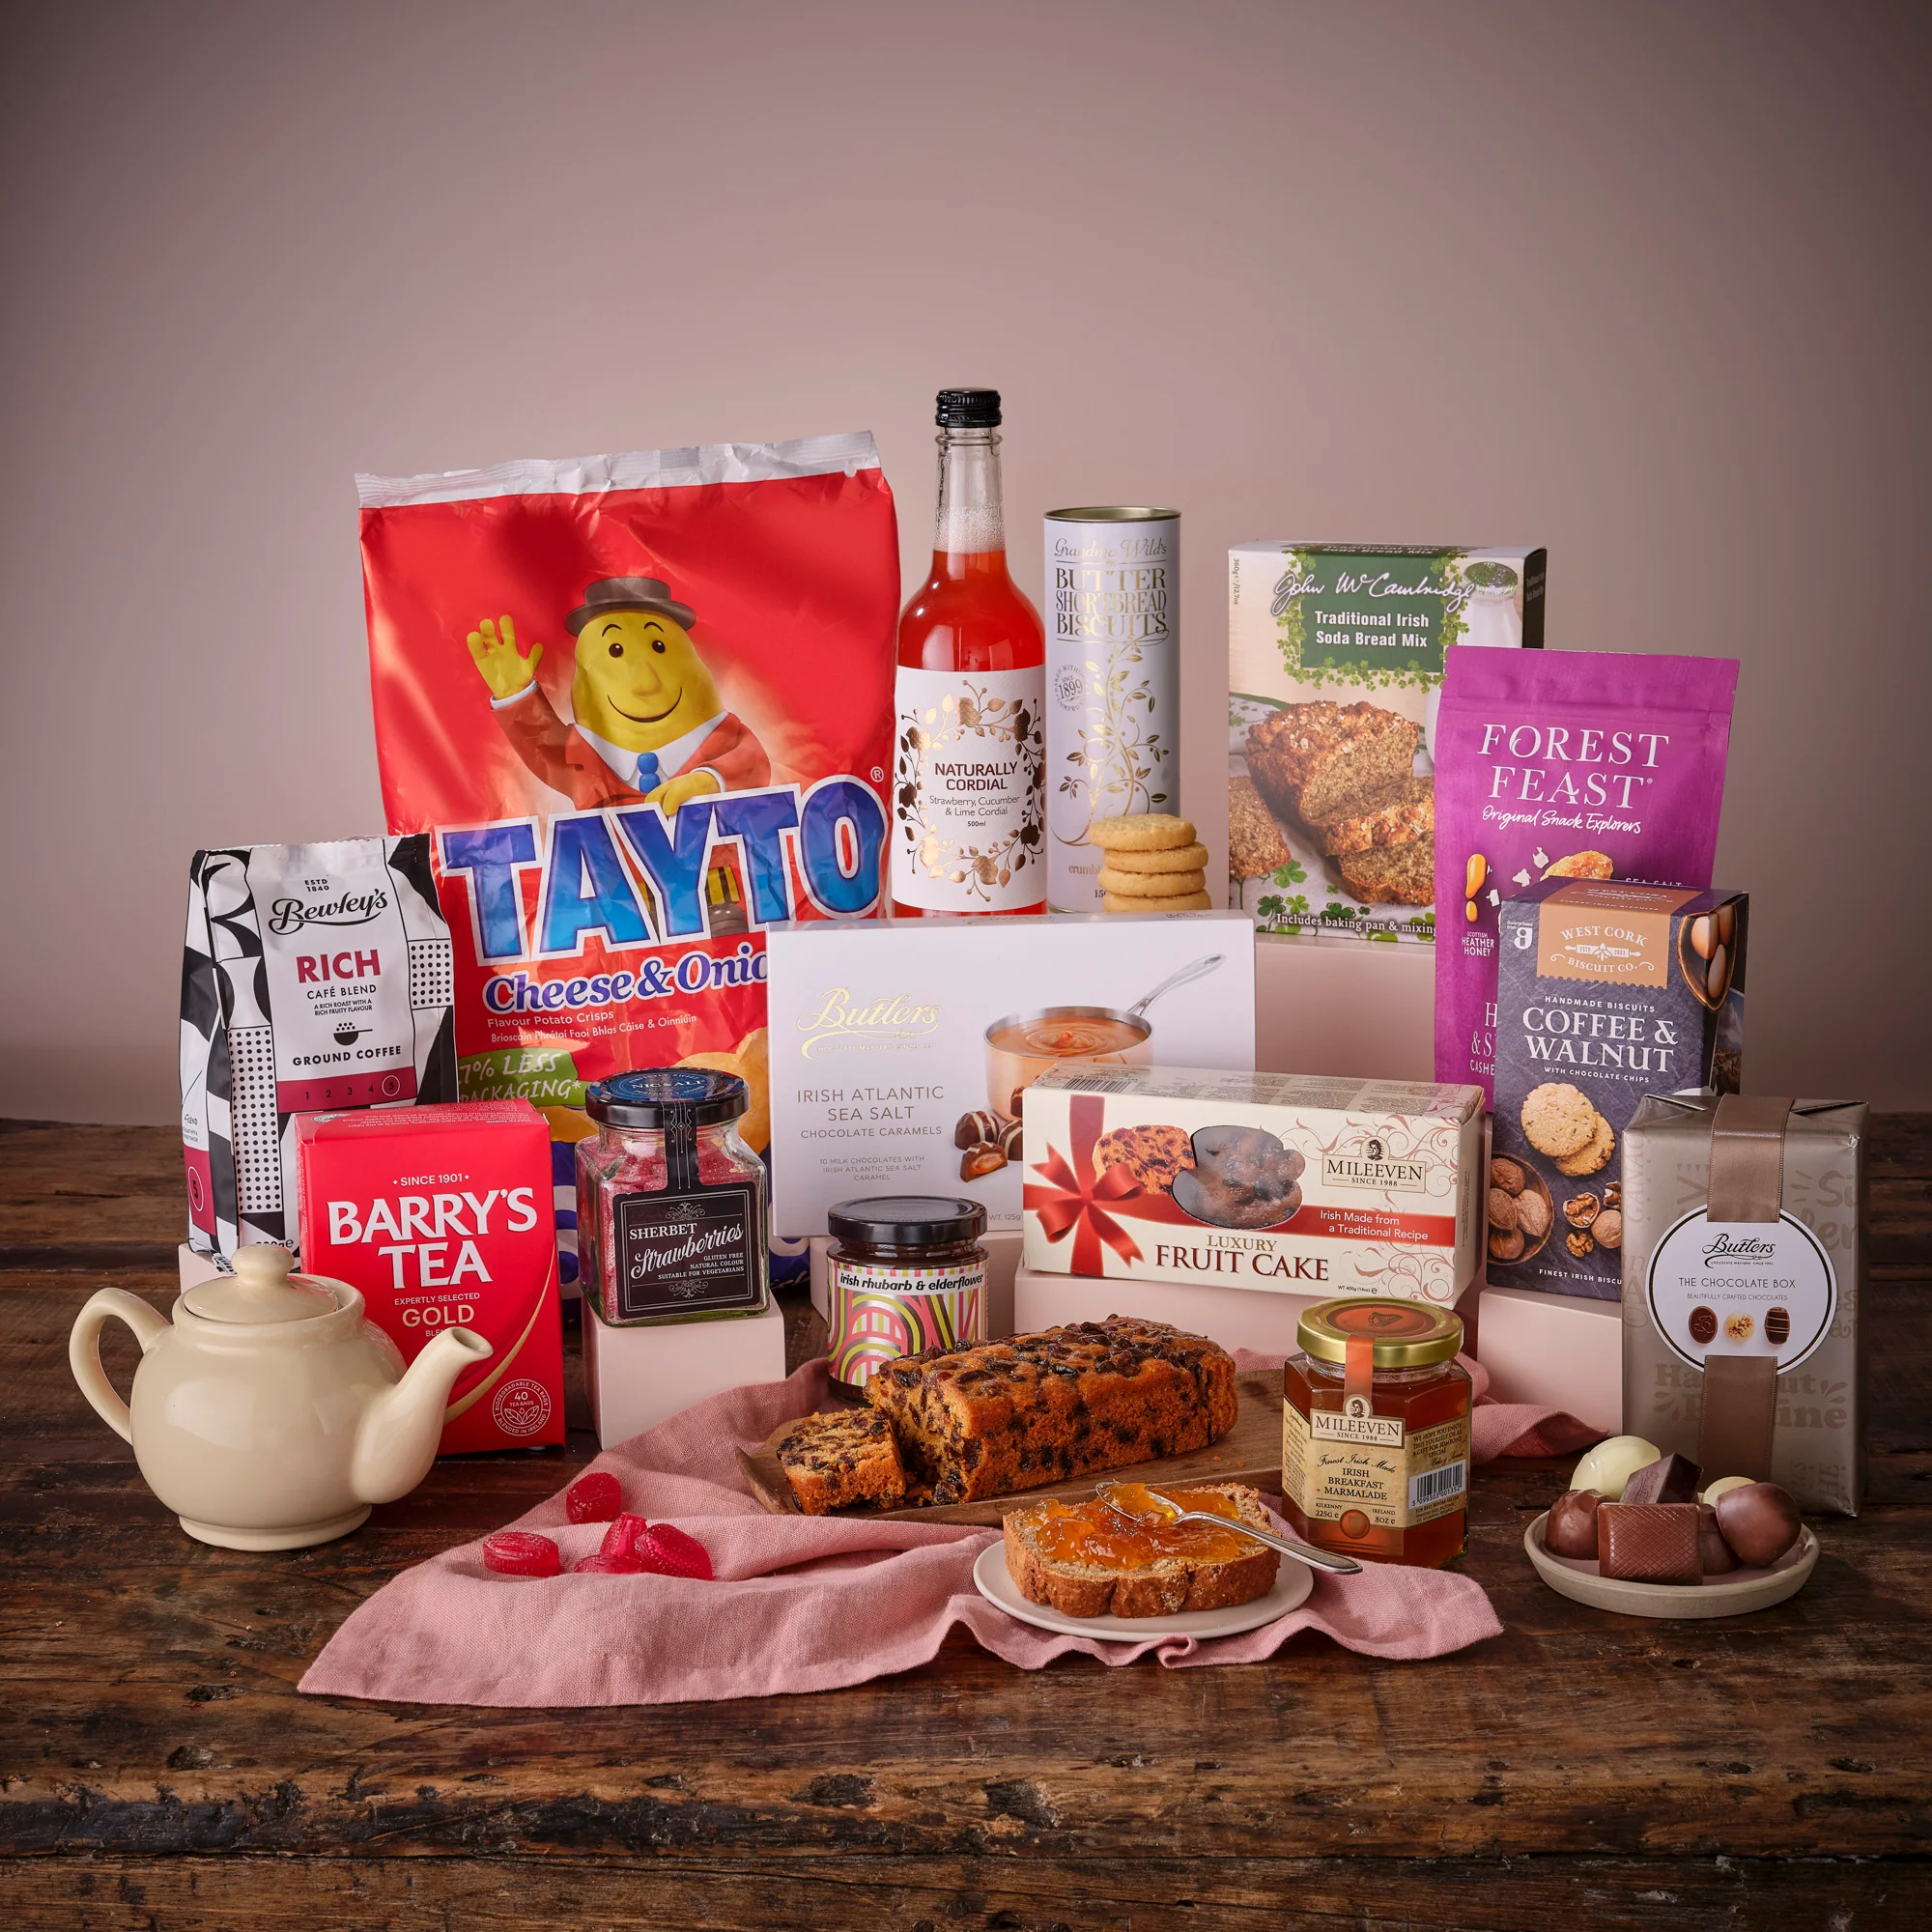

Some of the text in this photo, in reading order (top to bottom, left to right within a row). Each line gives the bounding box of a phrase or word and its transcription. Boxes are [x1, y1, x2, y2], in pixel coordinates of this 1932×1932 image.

[1121, 539, 1167, 558] Wild's
[1056, 568, 1166, 590] BUTTER
[1056, 590, 1167, 613] SHORTBREAD
[1271, 572, 1325, 615] John
[1057, 612, 1166, 638] BISCUITS
[1315, 611, 1429, 628] Traditional Irish
[1316, 631, 1428, 647] Soda Bread Mix
[1059, 679, 1083, 698] 1899
[1477, 724, 1669, 768] FOREST
[934, 762, 1018, 776] NATURALLY
[946, 779, 1008, 791] CORDIAL
[929, 795, 1020, 808] Strawberry, Cucumber
[945, 807, 1008, 816] & Lime Cordial
[1482, 805, 1641, 835] Original Snack Explorers
[438, 778, 888, 964] TAYTO
[268, 888, 388, 936] Bewley's
[1276, 913, 1322, 926] Includes
[1325, 916, 1362, 932] baking
[1365, 921, 1385, 933] pan
[1388, 921, 1398, 931] &
[1462, 937, 1494, 949] HEATHER
[1561, 925, 1648, 947] WEST CORK
[1463, 946, 1492, 957] HONEY
[296, 948, 381, 984] RICH
[1568, 956, 1637, 973] BISCUIT CO.
[306, 983, 377, 1001] CAFÉ BLEND
[485, 969, 635, 1012] Cheese
[638, 967, 673, 996] &
[328, 1007, 347, 1015] FRUITY
[349, 1005, 373, 1014] FLAVOUR
[333, 1001, 352, 1009] ROAST
[352, 1000, 366, 1009] WITH
[796, 986, 942, 1039] Butlers
[1545, 995, 1656, 1013] HANDMADE BISCUITS
[487, 1010, 614, 1028] Flavour Potato Crisps
[1522, 1007, 1645, 1041] COFFEE
[1654, 1020, 1678, 1045] &
[569, 1028, 590, 1038] Faoi
[592, 1026, 616, 1037] Bhlas
[619, 1020, 644, 1034] Cáise
[647, 1019, 655, 1029] &
[293, 1045, 401, 1066] GROUND COFFEE
[1523, 1034, 1674, 1072] WALNUT
[502, 1052, 562, 1076] LESS
[1569, 1068, 1621, 1080] CHOCOLATE
[1623, 1074, 1650, 1083] CHIPS
[797, 1086, 945, 1103] IRISH ATLANTIC
[828, 1106, 915, 1122] SEA SALT
[801, 1126, 942, 1138] CHOCOLATE CARAMELS
[1326, 1159, 1423, 1181] MILEEVEN
[400, 1173, 463, 1187] SINCE 1901
[1350, 1177, 1398, 1187] SINCE 1988
[327, 1187, 538, 1245] BARRY'S
[1005, 1213, 1021, 1222] 125g
[1320, 1209, 1400, 1226] Irish Made from
[629, 1223, 697, 1239] SHERBET
[1337, 1223, 1392, 1238] Traditional
[1394, 1228, 1429, 1243] Recipe
[631, 1224, 744, 1279] Strawberries
[1207, 1235, 1278, 1253] LUXURY
[1702, 1233, 1776, 1258] Butlers
[378, 1240, 494, 1290] TEA
[690, 1259, 744, 1270] NATURAL COLOUR
[703, 1253, 727, 1262] GLUTEN
[1155, 1244, 1329, 1282] FRUIT CAKE
[658, 1271, 687, 1280] SUITABLE
[701, 1266, 744, 1275] VEGETARIANS
[839, 1272, 983, 1291] irish rhubarb & elderflower
[1539, 1268, 1568, 1278] FINEST
[1571, 1272, 1595, 1282] IRISH
[1679, 1277, 1796, 1289] THE CHOCOLATE BOX
[394, 1293, 480, 1306] EXPERTLY SELECTED
[402, 1304, 474, 1327] GOLD
[514, 1391, 528, 1401] 40
[1315, 1415, 1401, 1437] MILEEVEN
[1337, 1432, 1360, 1440] SINCE
[1317, 1453, 1396, 1474] Finest Irish Made
[1343, 1467, 1370, 1478] IRISH
[1327, 1476, 1384, 1490] BREAKFAST
[1323, 1487, 1387, 1500] MARMALADE
[1316, 1509, 1333, 1519] 225G
